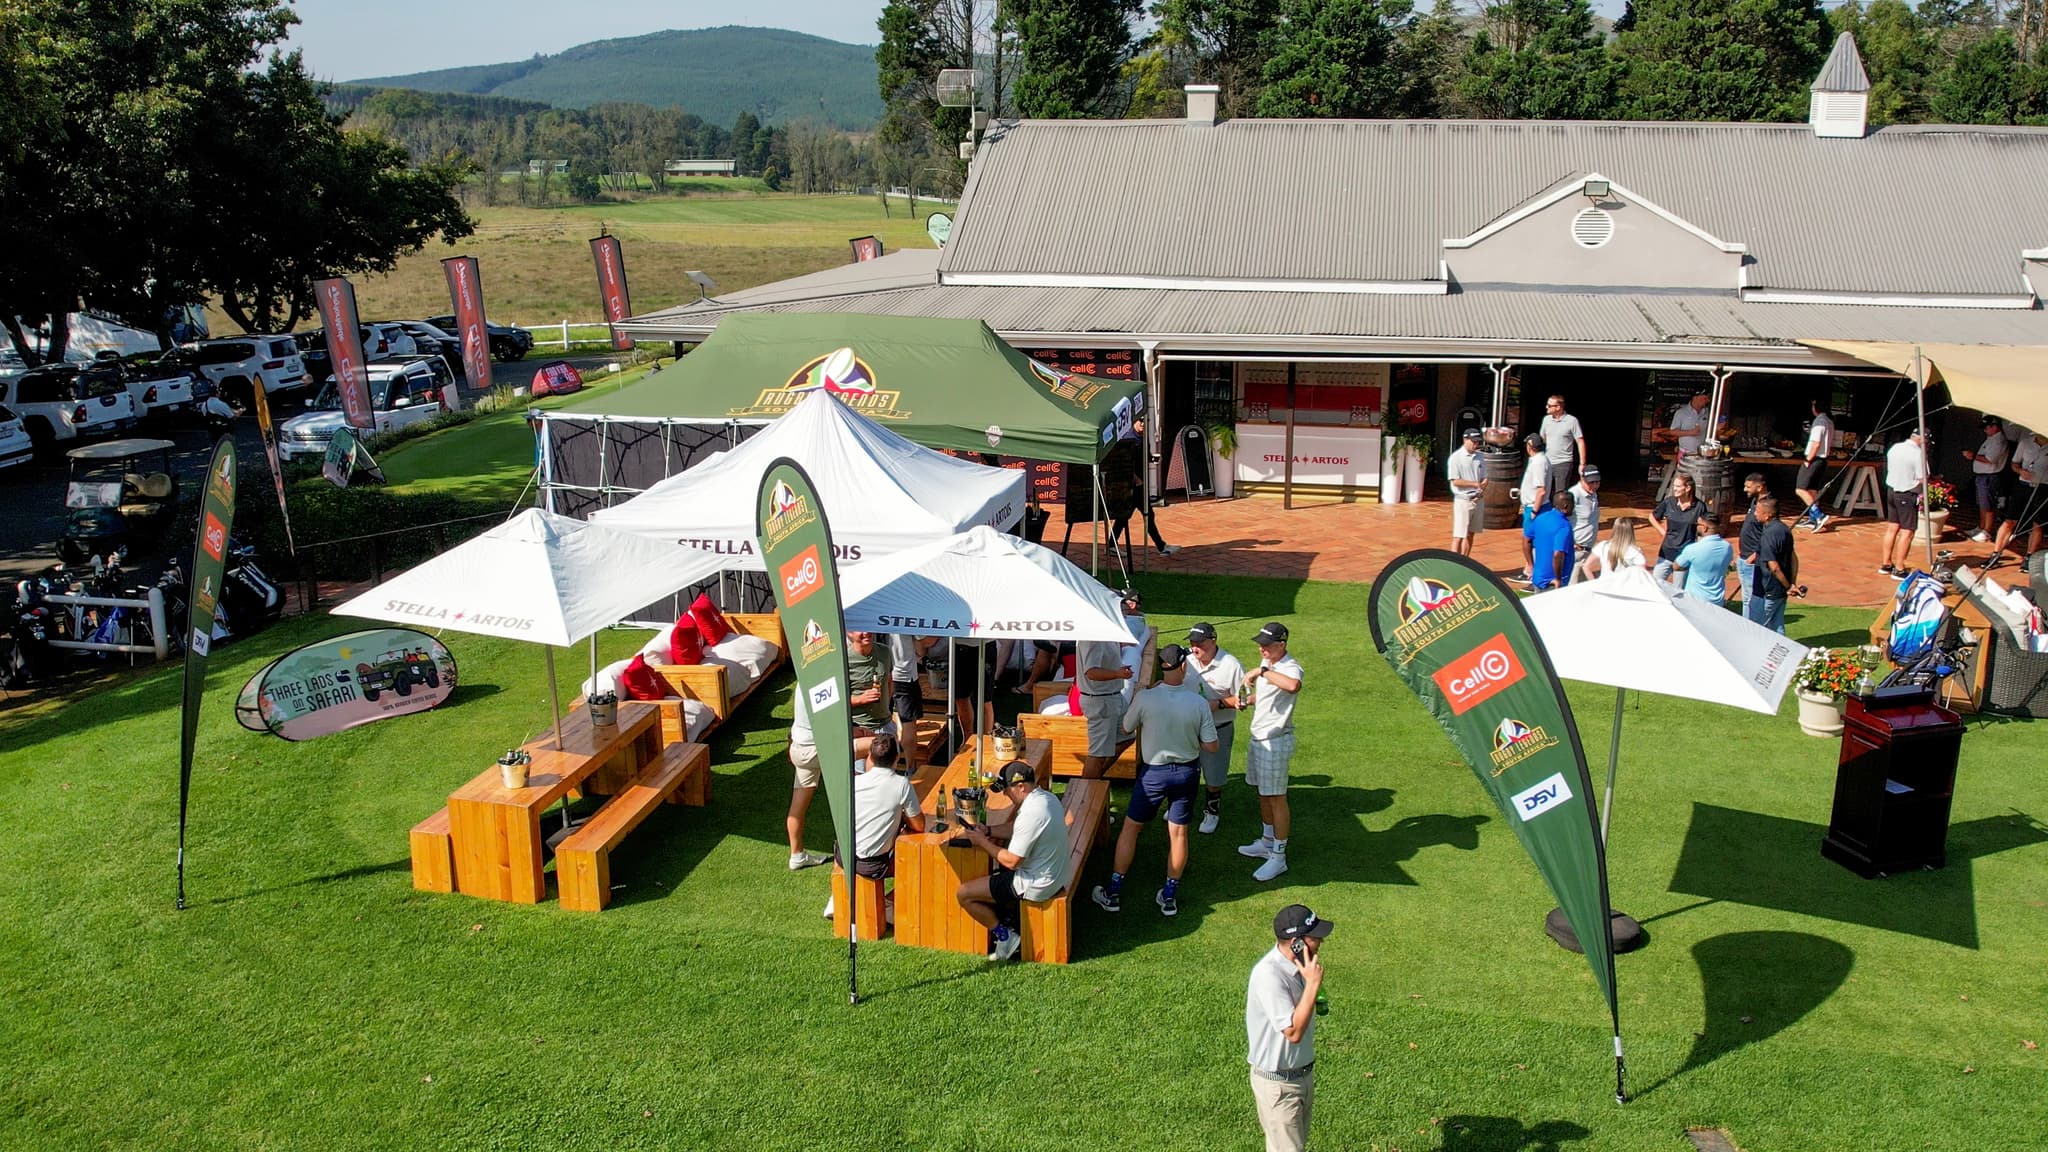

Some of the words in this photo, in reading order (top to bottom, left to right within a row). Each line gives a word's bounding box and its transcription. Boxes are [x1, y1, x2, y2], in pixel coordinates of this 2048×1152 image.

[763, 391, 810, 406] RUGB
[834, 391, 889, 408] GENDS
[1263, 454, 1300, 464] STELA
[1311, 456, 1349, 465] ARTOIS
[1038, 490, 1059, 500] ellC
[384, 599, 449, 619] STELLA
[466, 613, 535, 631] ARTOIS
[877, 615, 960, 630] STELLA
[989, 620, 1075, 632] ARTOIS
[1400, 614, 1434, 643] RUGBY
[1431, 590, 1475, 624] LEGENDS
[1413, 628, 1444, 649] SOUTH
[1445, 606, 1478, 628] AFRICA
[270, 683, 304, 702] THREE
[305, 673, 334, 692] LADS
[1754, 665, 1777, 690] STELLA
[306, 684, 357, 712] SAFARI
[814, 685, 832, 705] DSV
[1523, 783, 1557, 811] DSV
